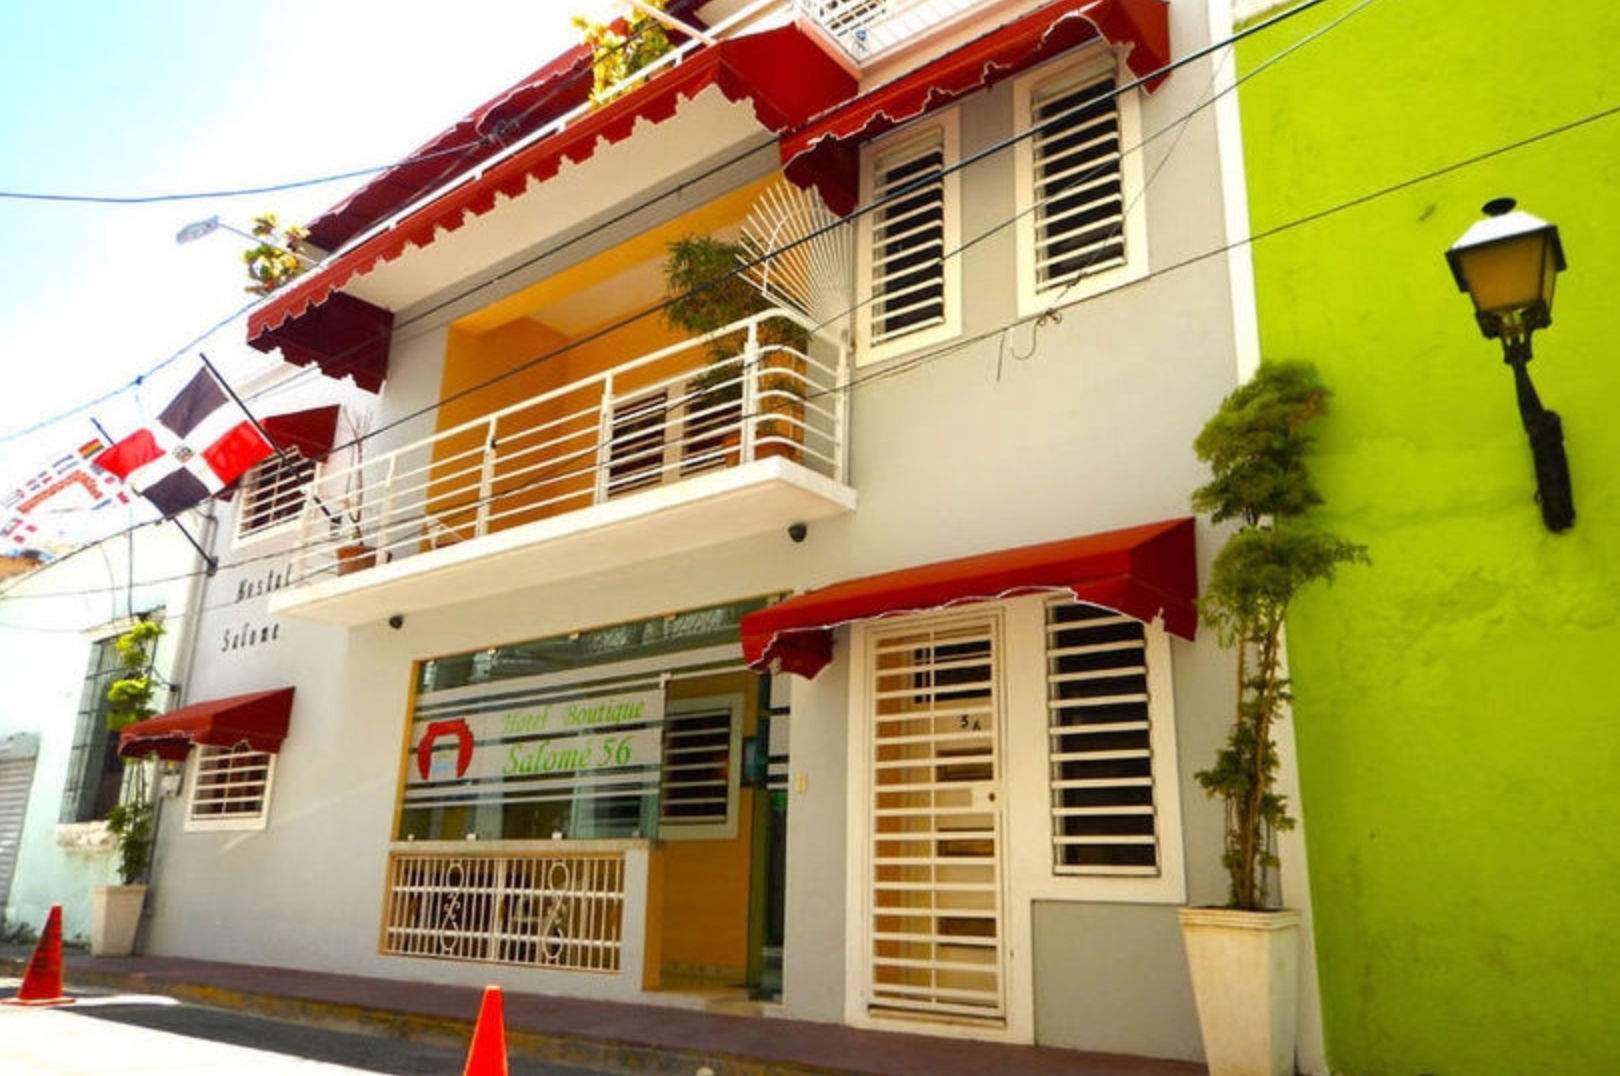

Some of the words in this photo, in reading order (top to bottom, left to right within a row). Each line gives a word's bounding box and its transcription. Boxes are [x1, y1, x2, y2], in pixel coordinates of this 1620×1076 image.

[504, 706, 550, 733] Hotel
[566, 699, 644, 724] Boutique
[596, 735, 635, 767] 56
